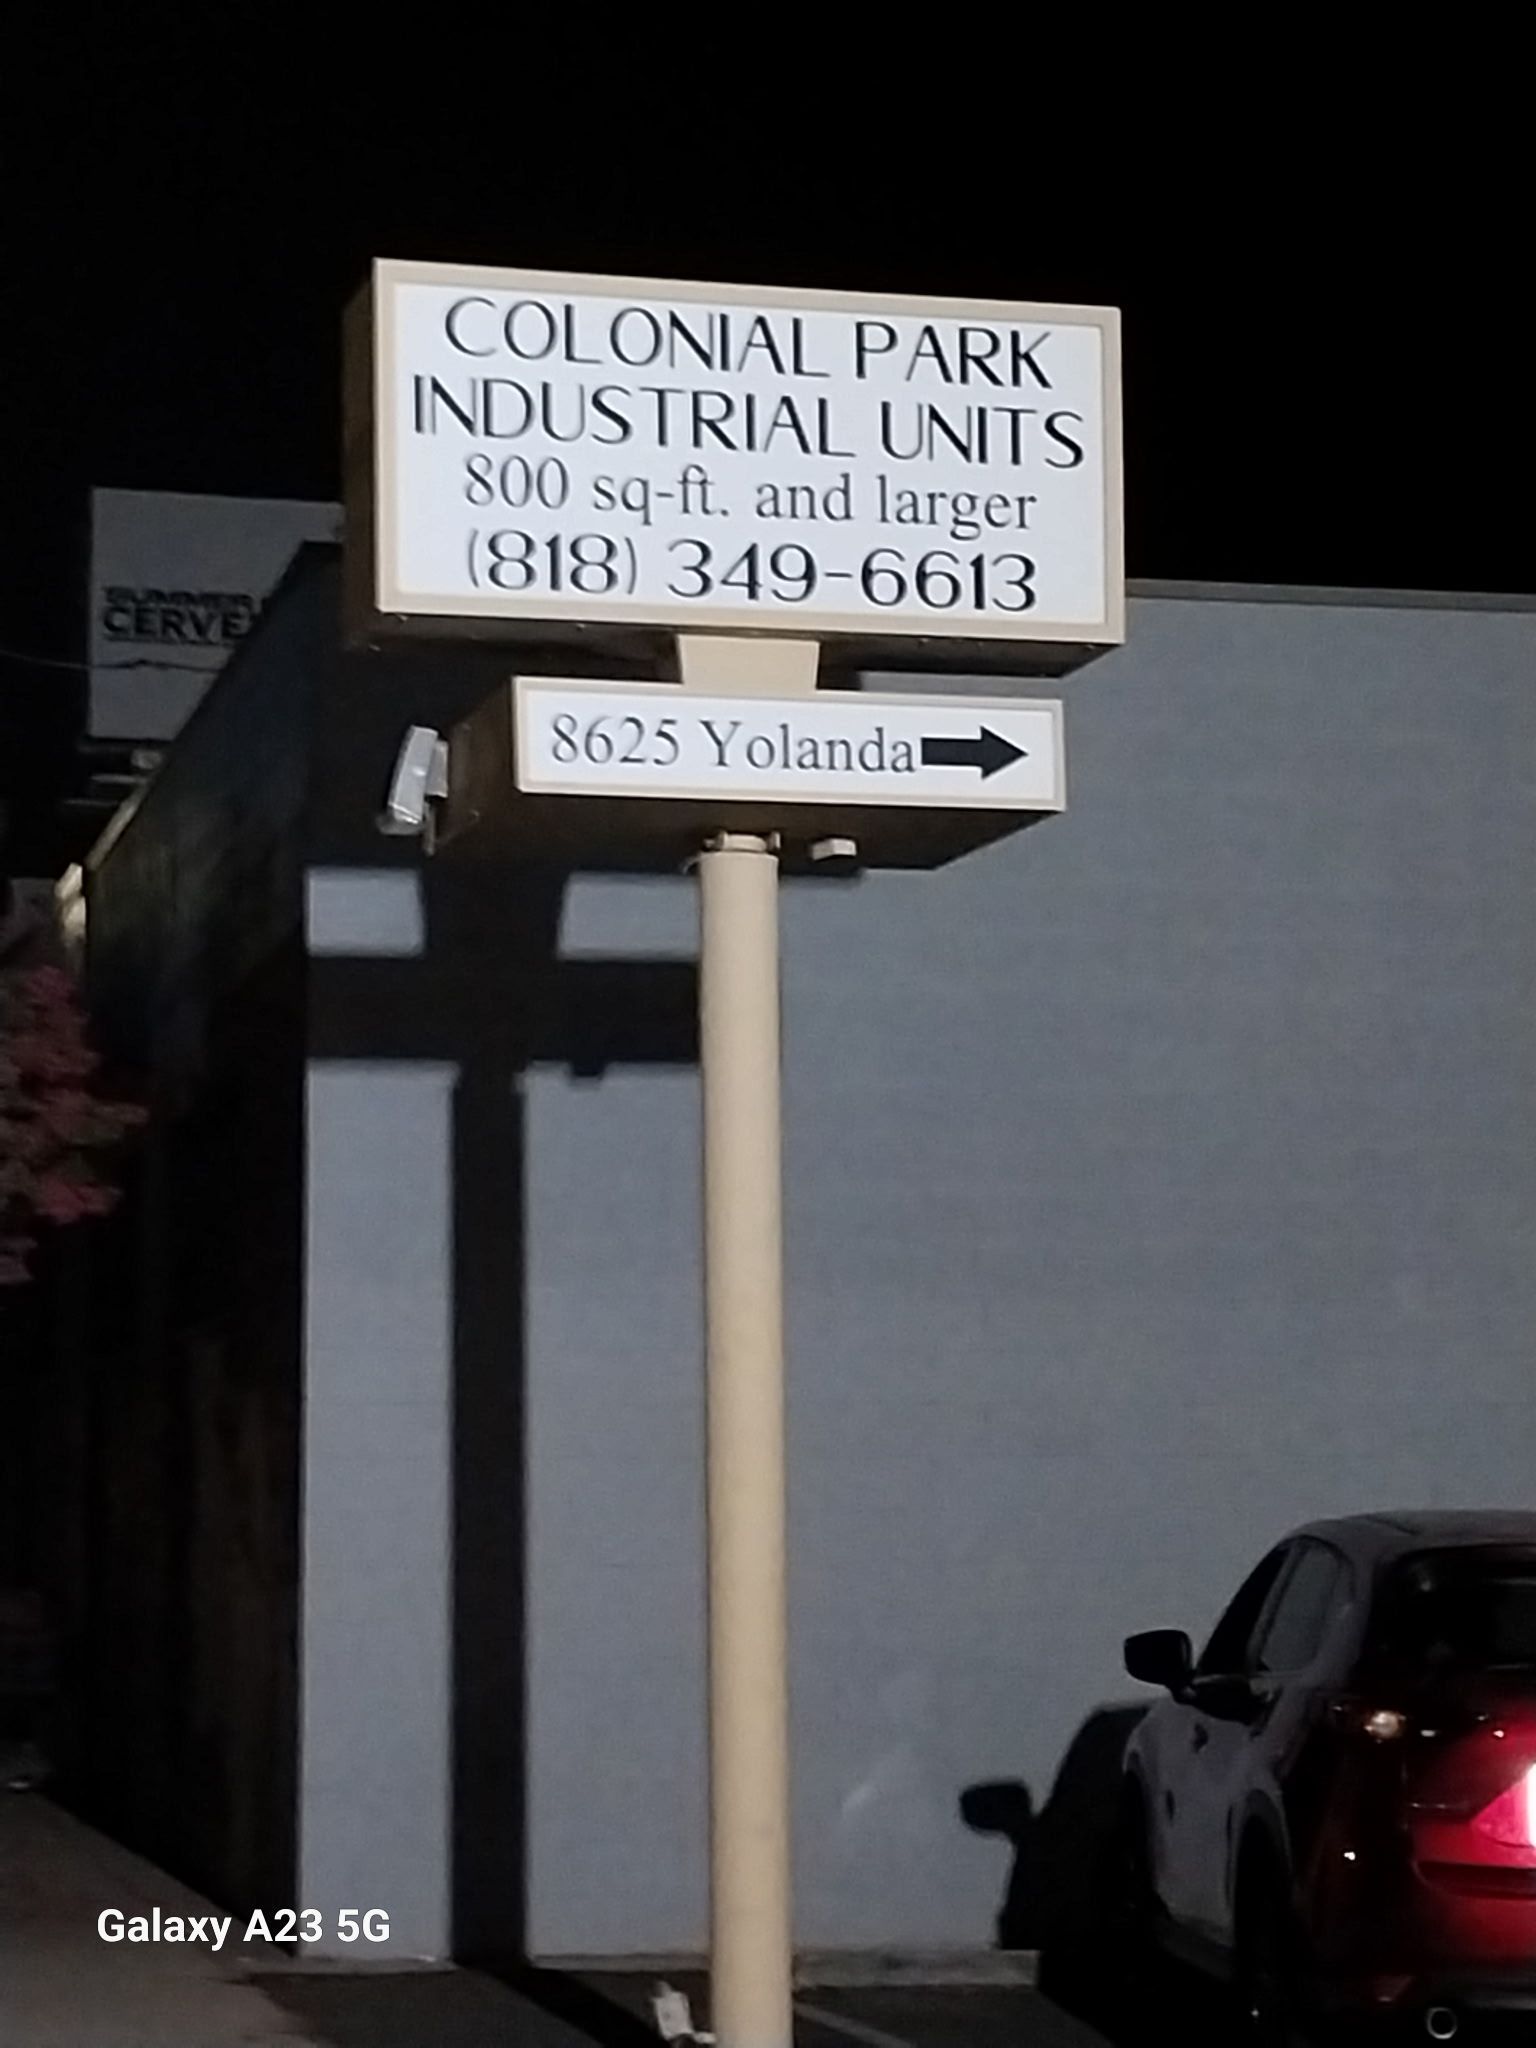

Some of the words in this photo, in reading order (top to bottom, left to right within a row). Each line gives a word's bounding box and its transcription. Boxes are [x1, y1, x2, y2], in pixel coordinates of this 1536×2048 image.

[444, 297, 830, 378] COLONIAL
[854, 320, 1054, 390] PARK
[412, 374, 857, 458] INDUSTRIAL
[880, 401, 1085, 470] UNITS
[464, 454, 570, 510] 800
[592, 464, 730, 526] sq-ft.
[754, 474, 853, 523] and
[876, 475, 1037, 540] larger
[466, 528, 639, 597] (818)
[666, 538, 1038, 612] 349-6613
[550, 713, 680, 765] 8625
[699, 720, 916, 774] Yolanda
